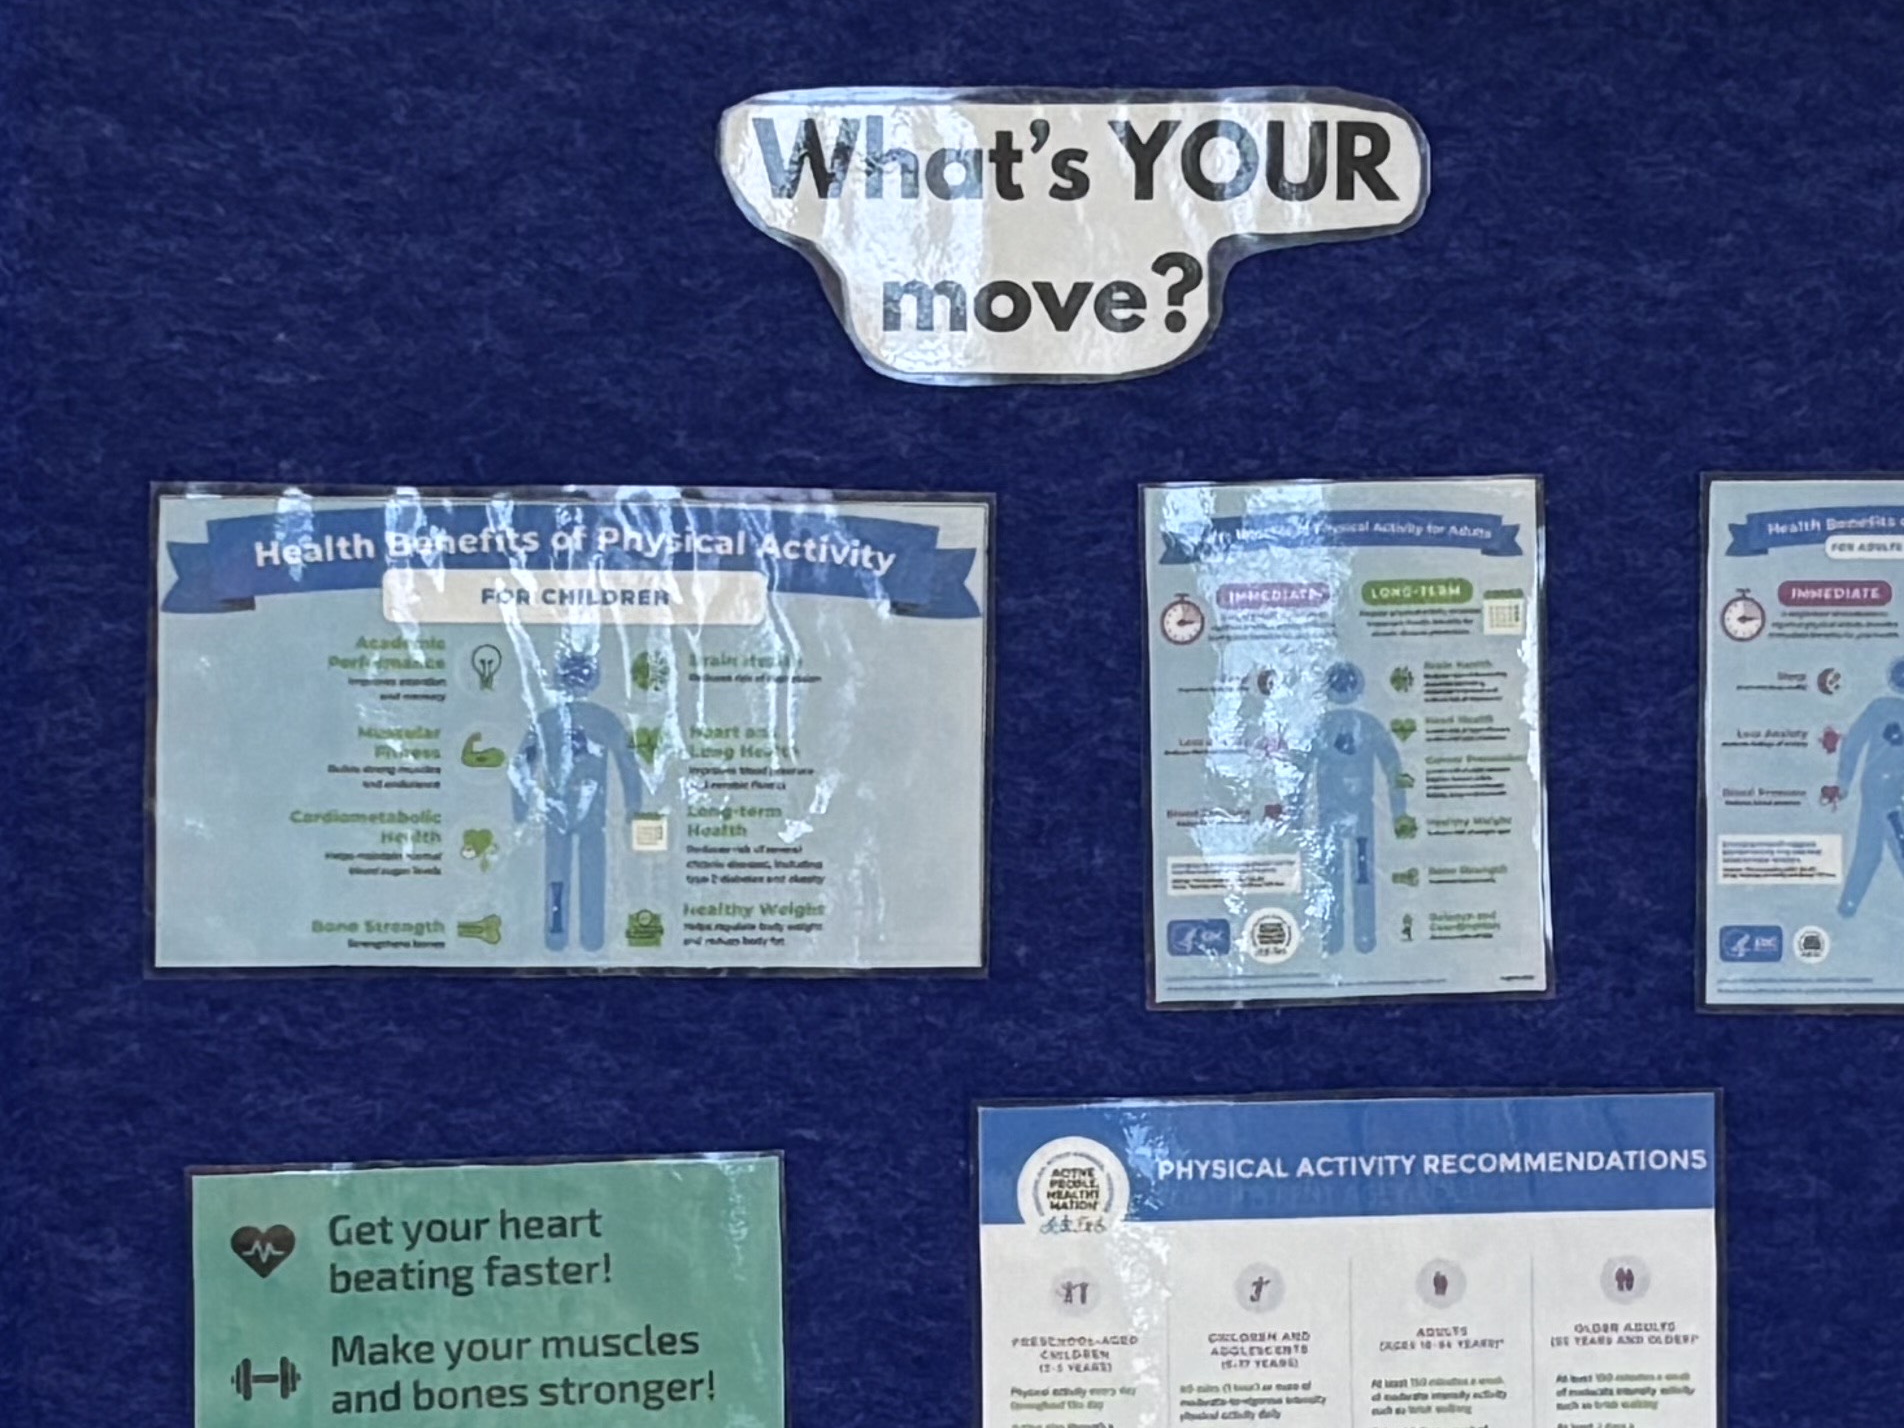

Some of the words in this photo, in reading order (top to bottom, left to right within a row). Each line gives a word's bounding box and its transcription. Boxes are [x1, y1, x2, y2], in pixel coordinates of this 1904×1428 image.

[751, 116, 1091, 201] What's
[1109, 118, 1400, 202] YOUR
[882, 252, 1204, 333] move?
[253, 531, 376, 570] Health
[384, 527, 543, 558] Benefits
[550, 526, 588, 554] of
[596, 526, 747, 562] Physical
[757, 531, 900, 577] Activity
[481, 587, 530, 606] FOR
[541, 588, 670, 606] CHILDREN
[1156, 1158, 1290, 1182] PHYSICAL
[1296, 1154, 1416, 1177] ACTIVITY
[1423, 1149, 1707, 1175] RECOMMENDATIONS
[328, 1214, 393, 1247] Get
[401, 1217, 491, 1252] your
[500, 1208, 602, 1240] heart
[330, 1259, 474, 1297] beating
[483, 1252, 611, 1288] faster!
[332, 1333, 435, 1367] Make
[444, 1337, 532, 1371] your
[542, 1324, 699, 1359] muscles
[332, 1380, 401, 1414] and
[413, 1379, 529, 1411] bones
[538, 1370, 714, 1411] stronger!
